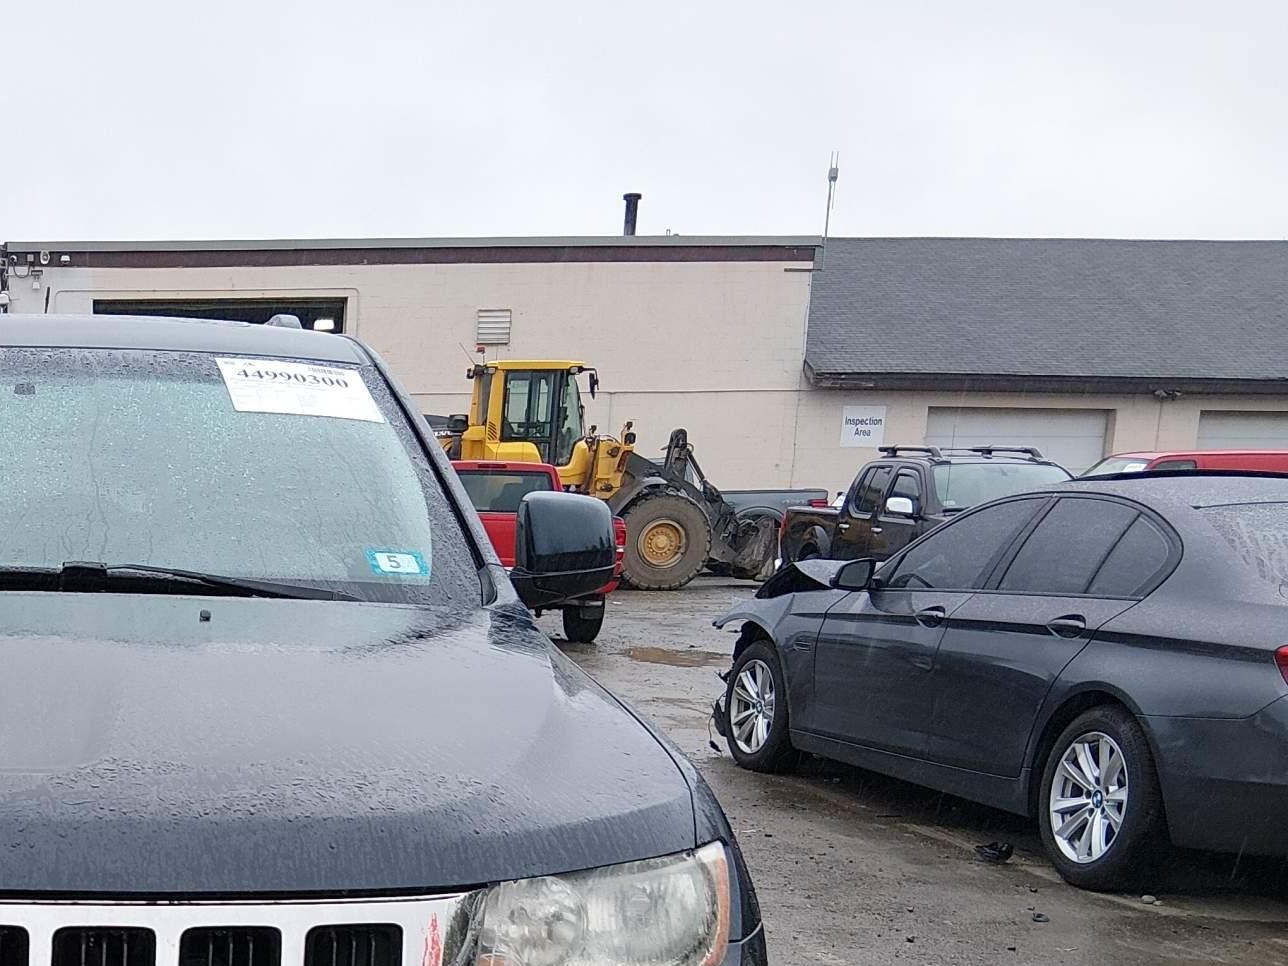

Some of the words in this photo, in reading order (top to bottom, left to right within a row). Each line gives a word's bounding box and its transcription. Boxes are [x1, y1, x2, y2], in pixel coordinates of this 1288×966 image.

[236, 369, 350, 389] 44990300
[844, 416, 883, 427] Inspection
[854, 427, 872, 437] Area
[386, 555, 402, 569] 5
